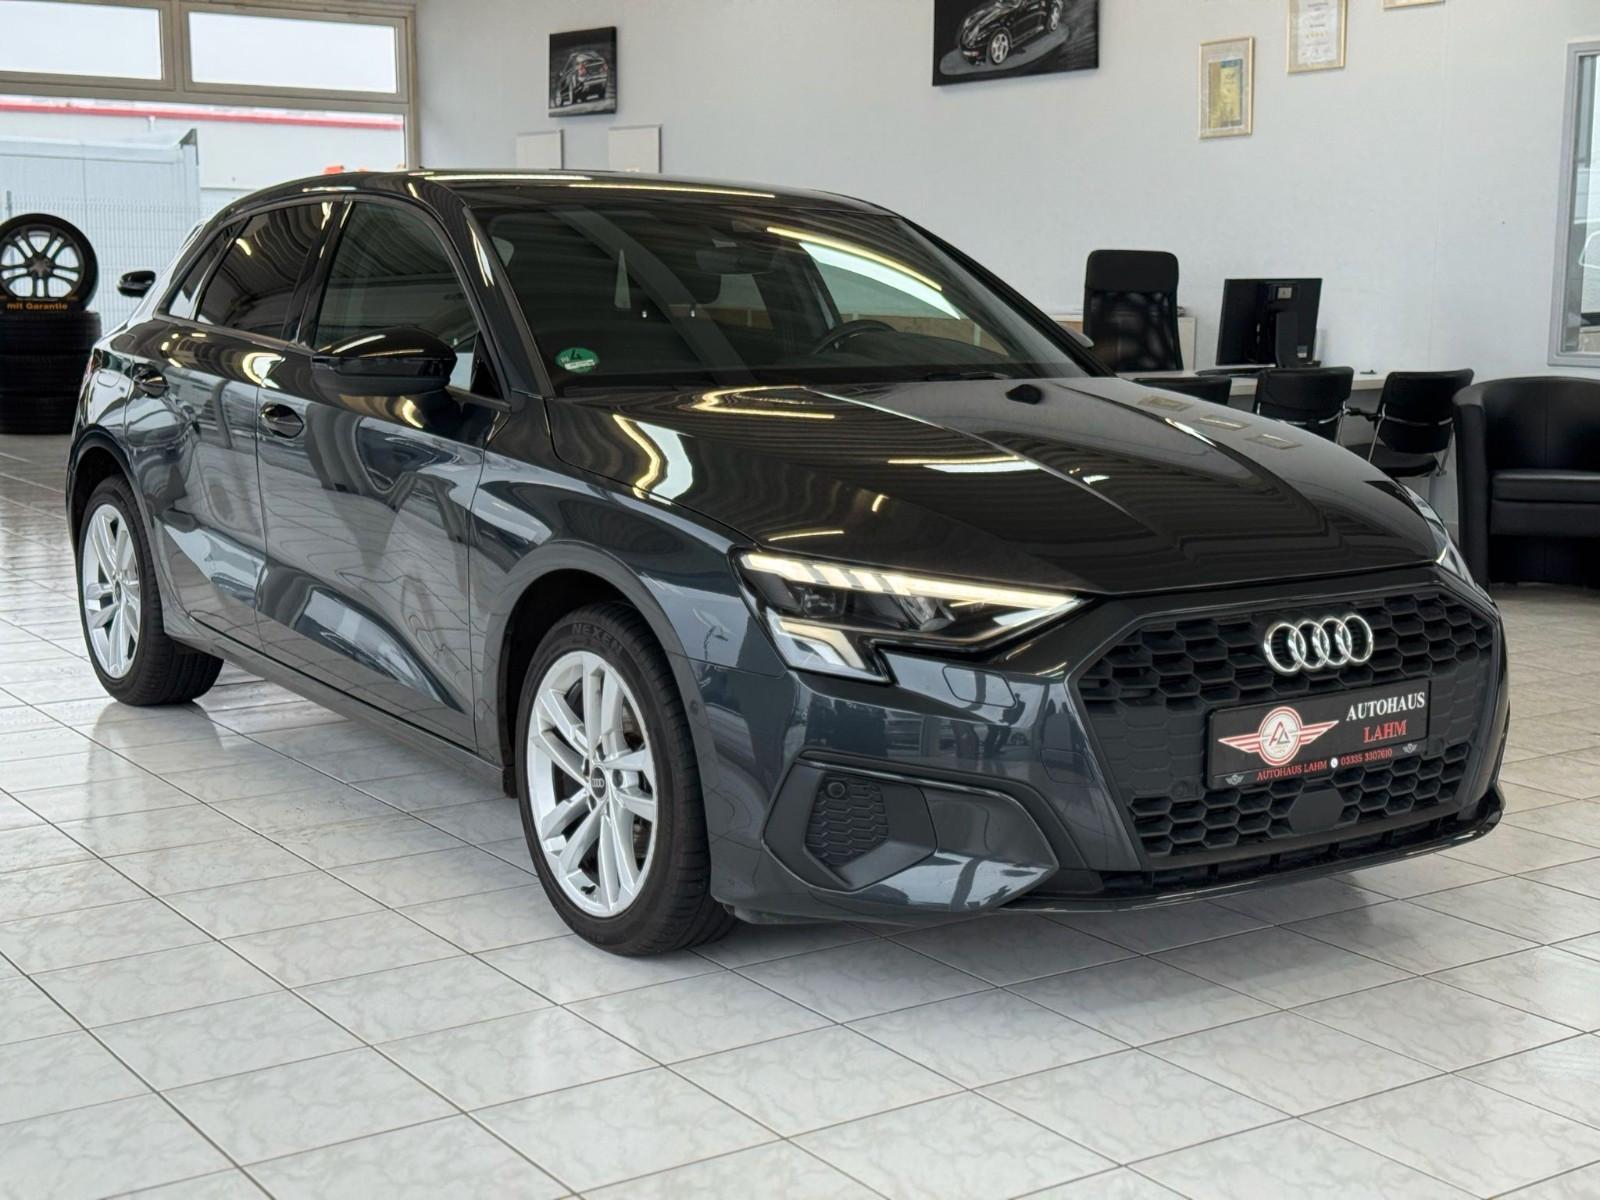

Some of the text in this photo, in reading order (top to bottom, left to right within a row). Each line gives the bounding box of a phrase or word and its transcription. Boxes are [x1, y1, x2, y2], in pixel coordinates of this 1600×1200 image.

[6, 302, 68, 310] mit Garantie
[570, 349, 582, 360] 4
[571, 623, 623, 653] NEXEN
[1345, 691, 1425, 721] AUTOHAUS
[1363, 720, 1407, 743] LAHM
[1256, 766, 1302, 781] AUTOHAUS
[1303, 760, 1328, 773] LAHM
